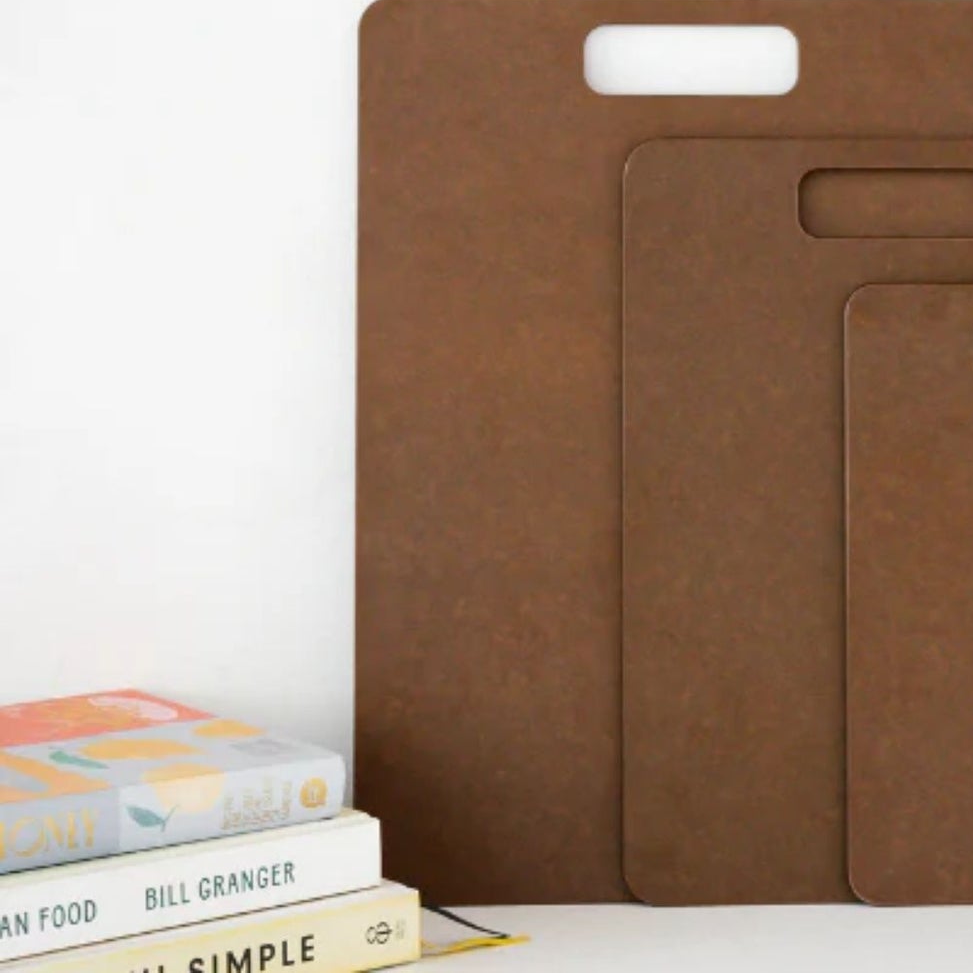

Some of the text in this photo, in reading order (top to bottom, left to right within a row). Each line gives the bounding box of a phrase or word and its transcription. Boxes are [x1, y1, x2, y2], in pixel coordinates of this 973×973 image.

[0, 861, 296, 940] AN FOOD BILL GRANGER
[188, 934, 315, 973] SIMPLE
